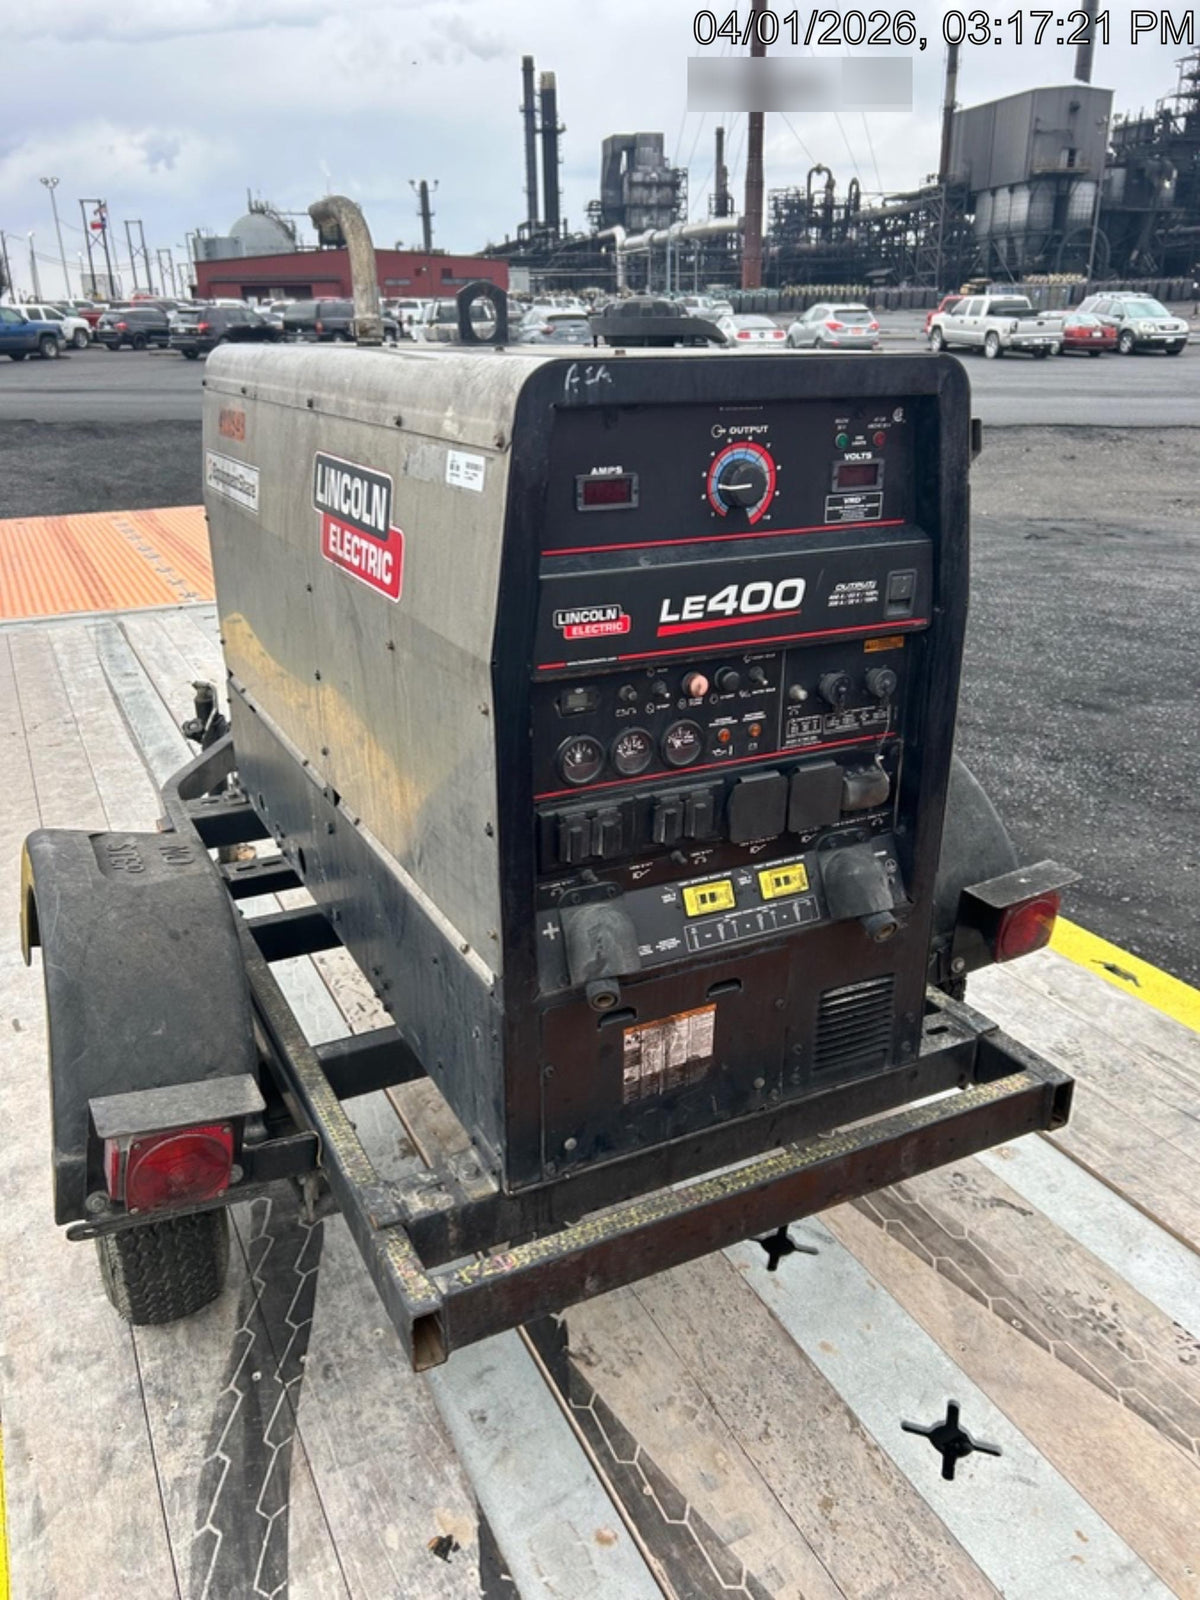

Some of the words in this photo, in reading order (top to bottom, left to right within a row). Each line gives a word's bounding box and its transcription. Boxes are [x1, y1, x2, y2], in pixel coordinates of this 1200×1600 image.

[728, 424, 769, 435] OUTPUT
[843, 451, 873, 461] VOLTS
[589, 465, 624, 476] AMPS
[315, 462, 387, 532] LINCOLN
[328, 522, 393, 586] ELECTRIC
[658, 577, 807, 623] LE400
[557, 607, 618, 626] LINCOLN
[571, 621, 624, 637] ELECTRIC
[106, 841, 145, 874] STEP
